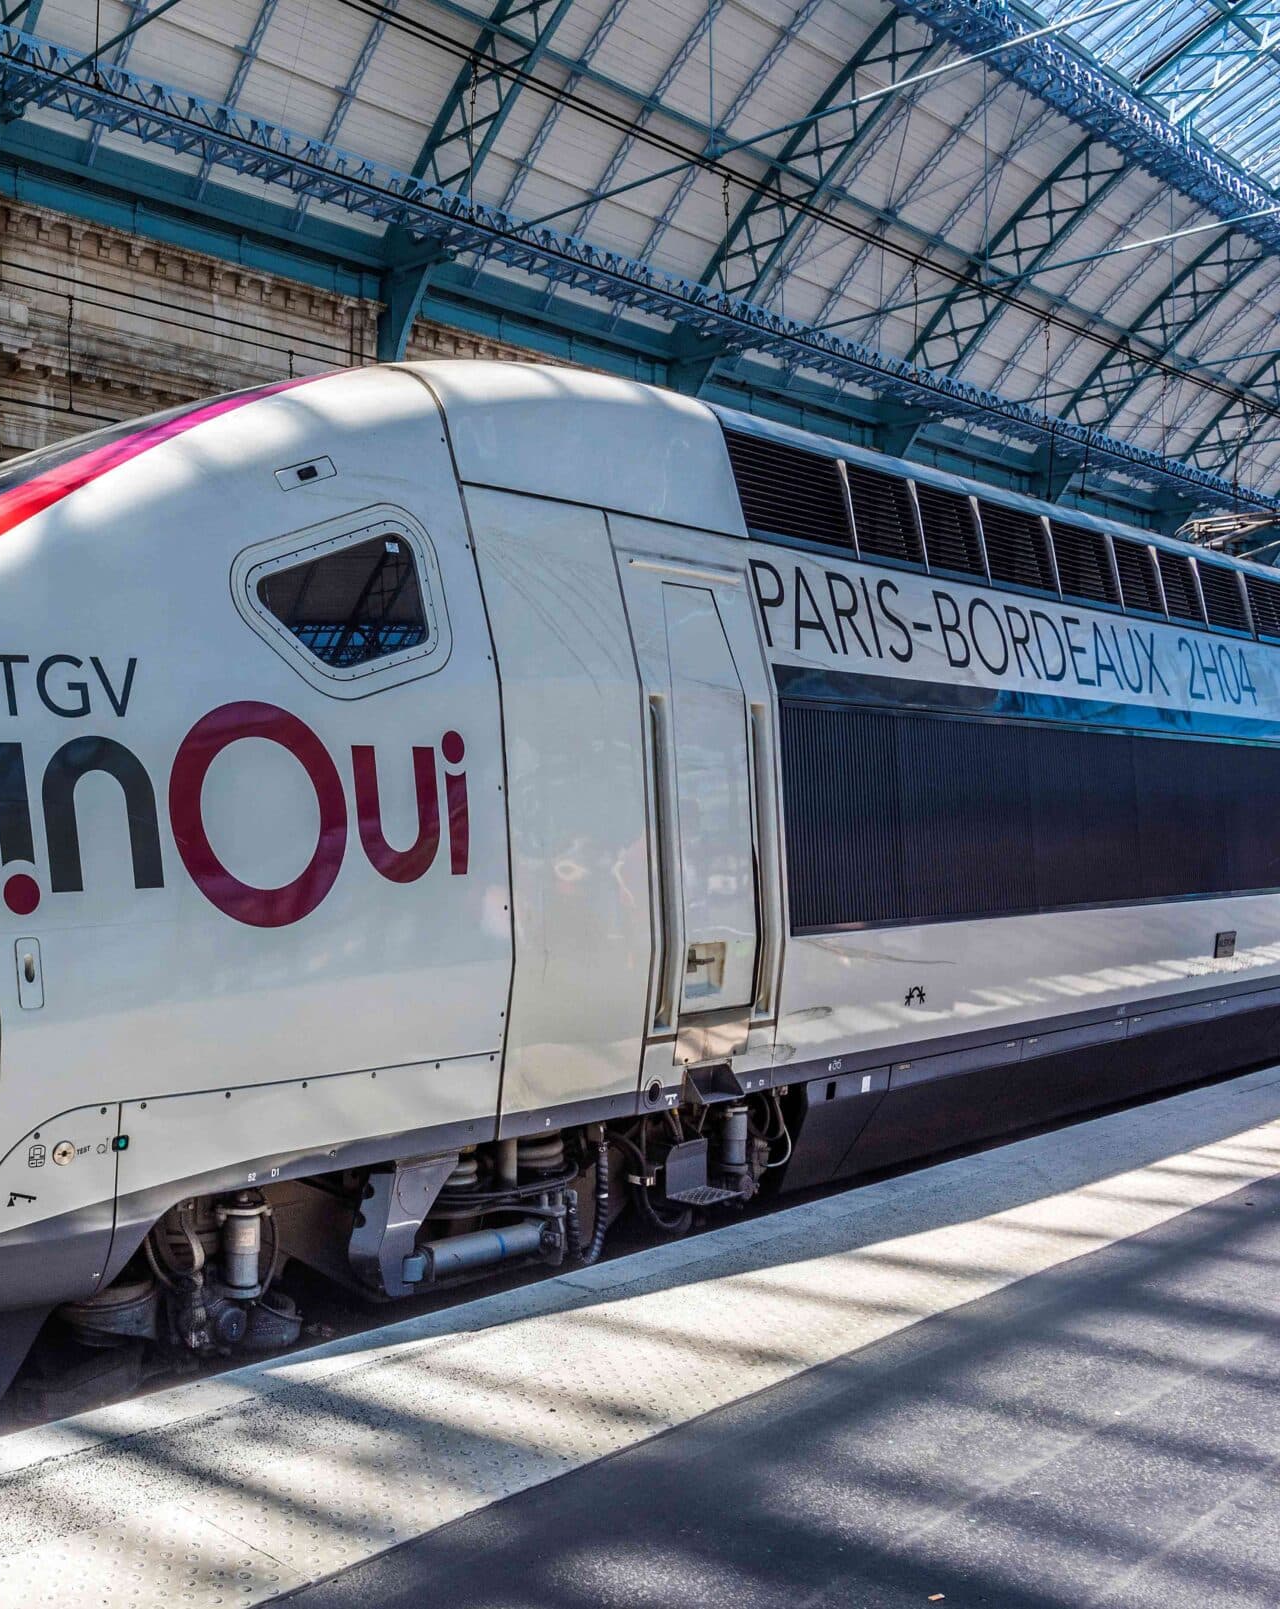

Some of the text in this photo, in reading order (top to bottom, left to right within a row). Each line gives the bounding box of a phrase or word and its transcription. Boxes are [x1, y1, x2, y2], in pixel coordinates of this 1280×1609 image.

[747, 558, 1259, 707] PARIS-BORDEAUX 2H04
[76, 1145, 91, 1155] TEST
